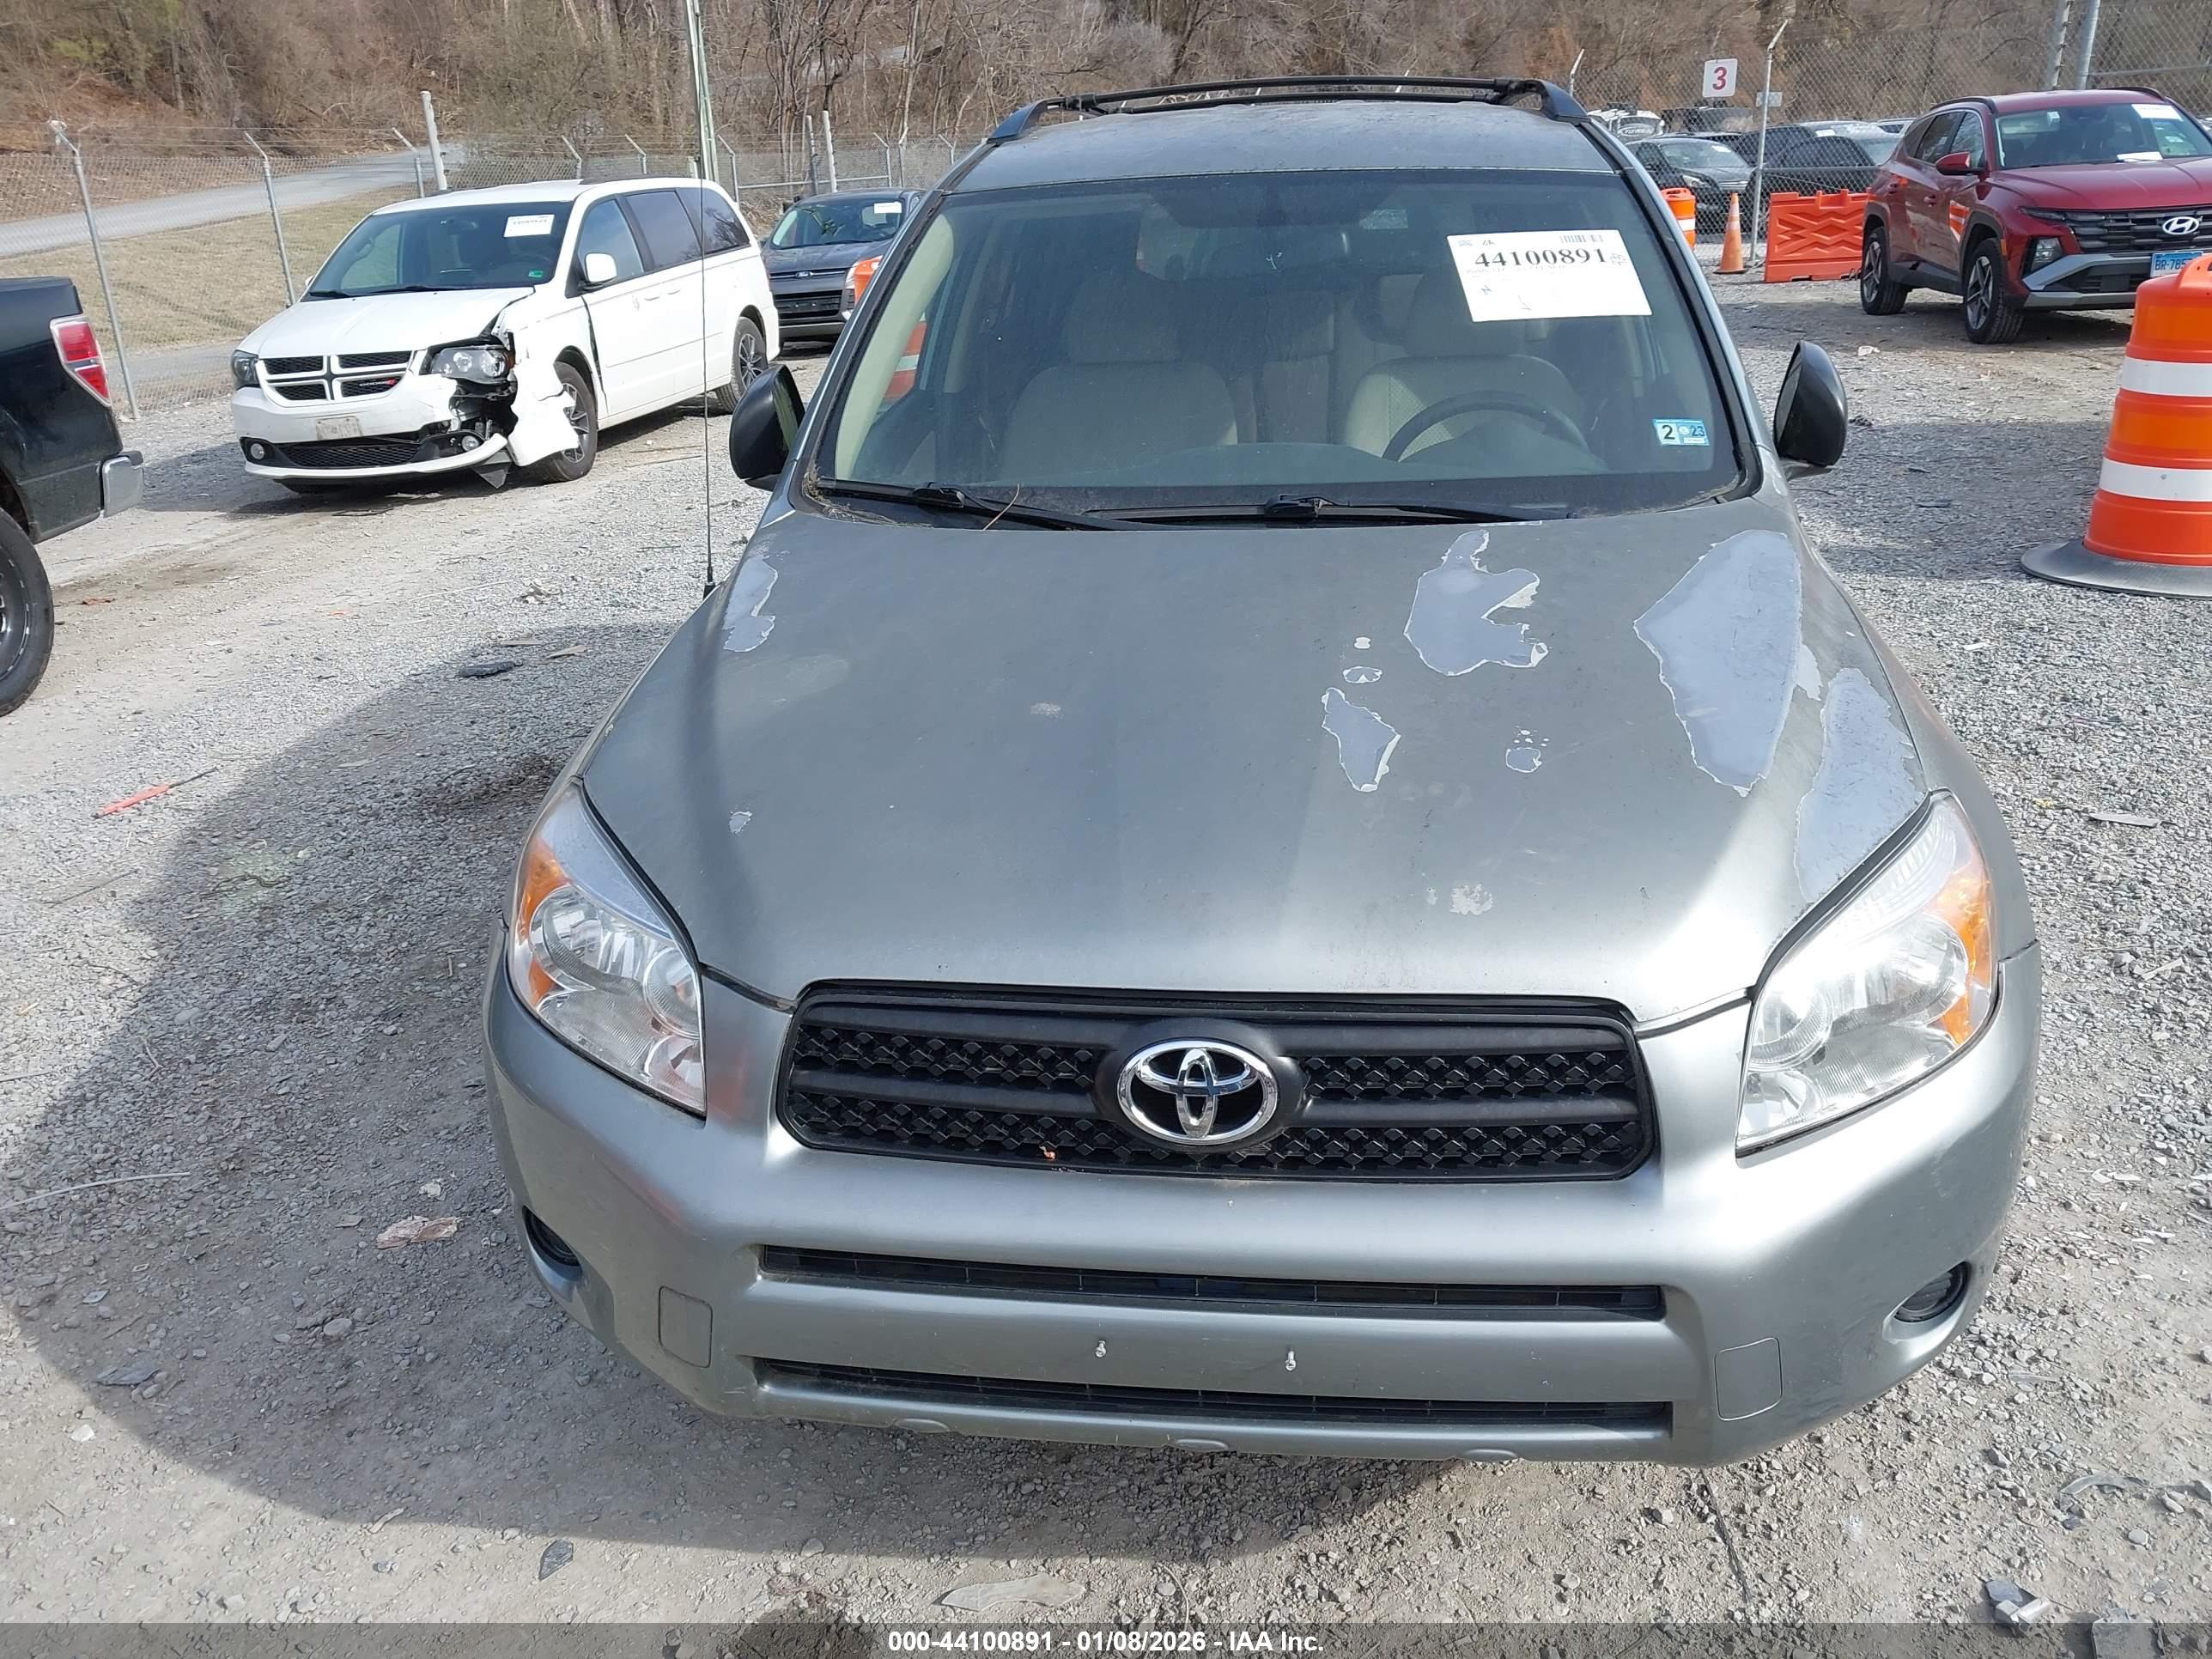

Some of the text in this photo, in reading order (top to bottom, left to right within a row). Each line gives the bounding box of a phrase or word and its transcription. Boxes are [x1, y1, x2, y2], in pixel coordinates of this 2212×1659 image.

[1712, 66, 1728, 90] 3
[1474, 247, 1607, 267] 44100891
[2154, 258, 2192, 271] BR-785
[1662, 424, 1676, 440] 2
